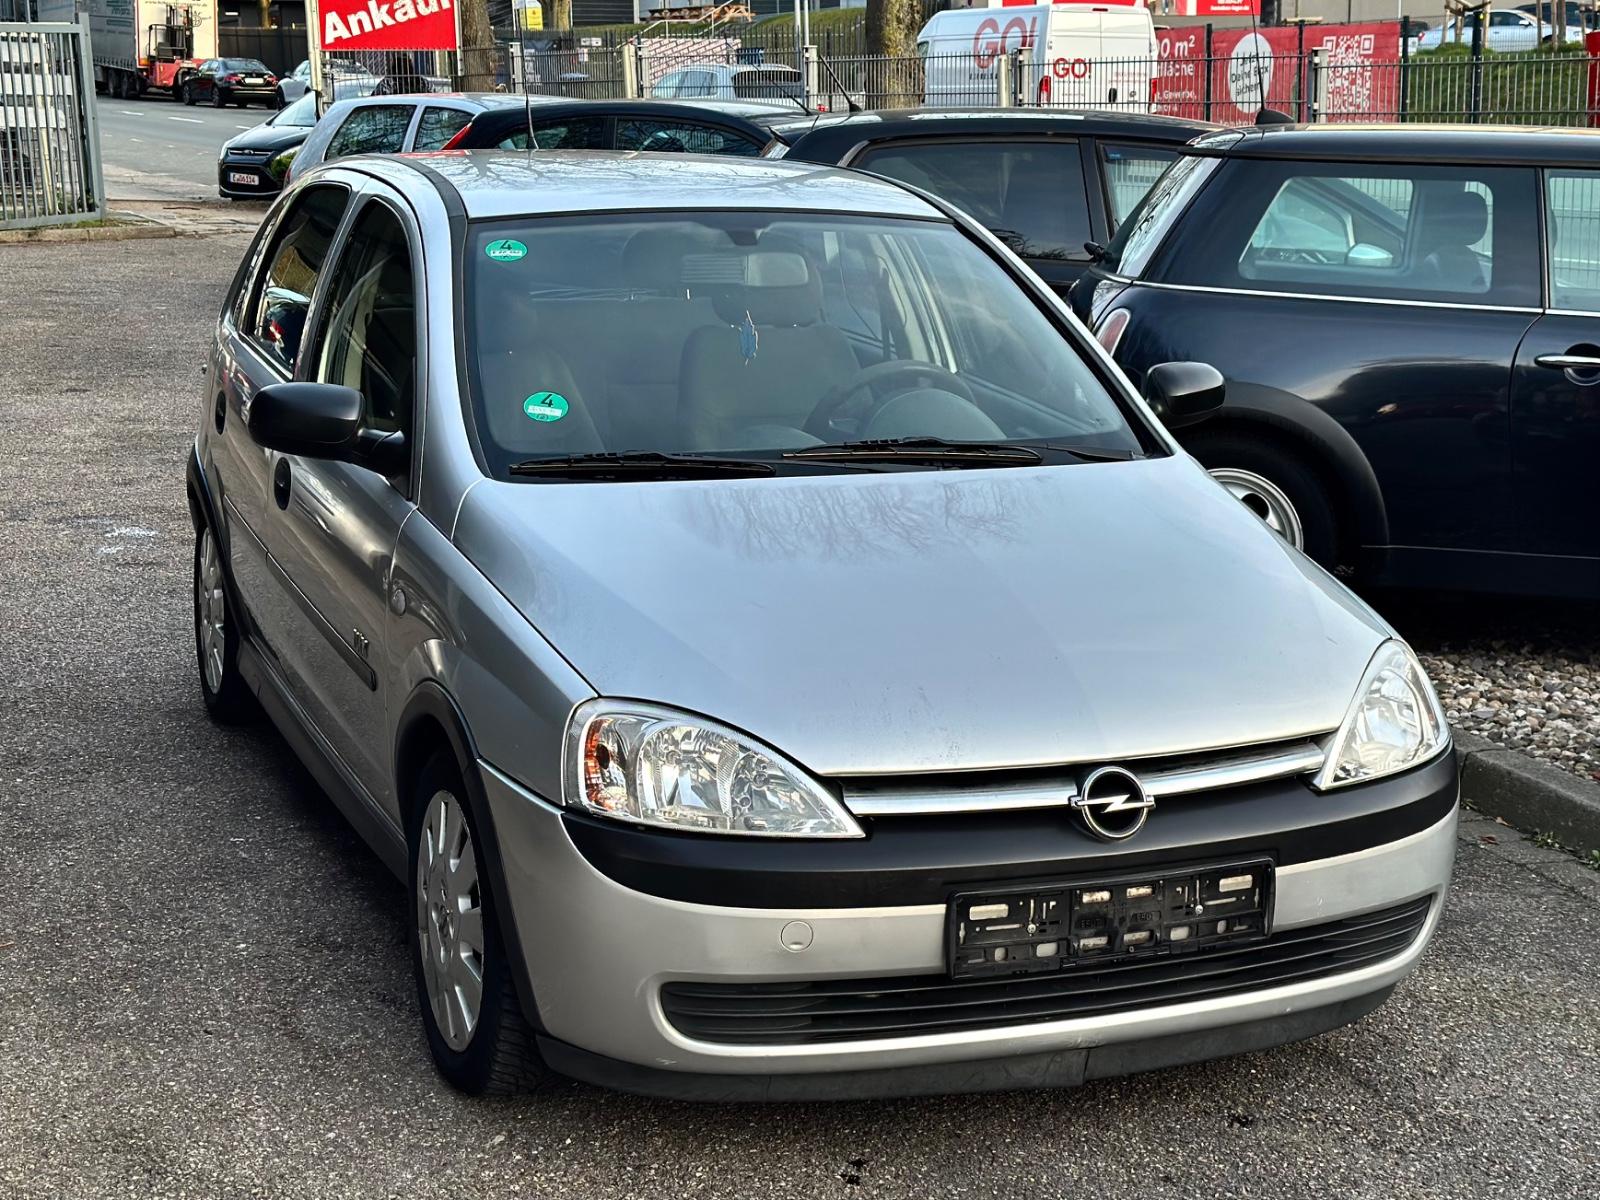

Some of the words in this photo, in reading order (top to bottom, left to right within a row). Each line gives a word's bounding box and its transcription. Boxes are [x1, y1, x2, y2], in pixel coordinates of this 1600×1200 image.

[1053, 58, 1092, 79] GO!
[500, 240, 512, 250] 4
[541, 393, 553, 407] 4
